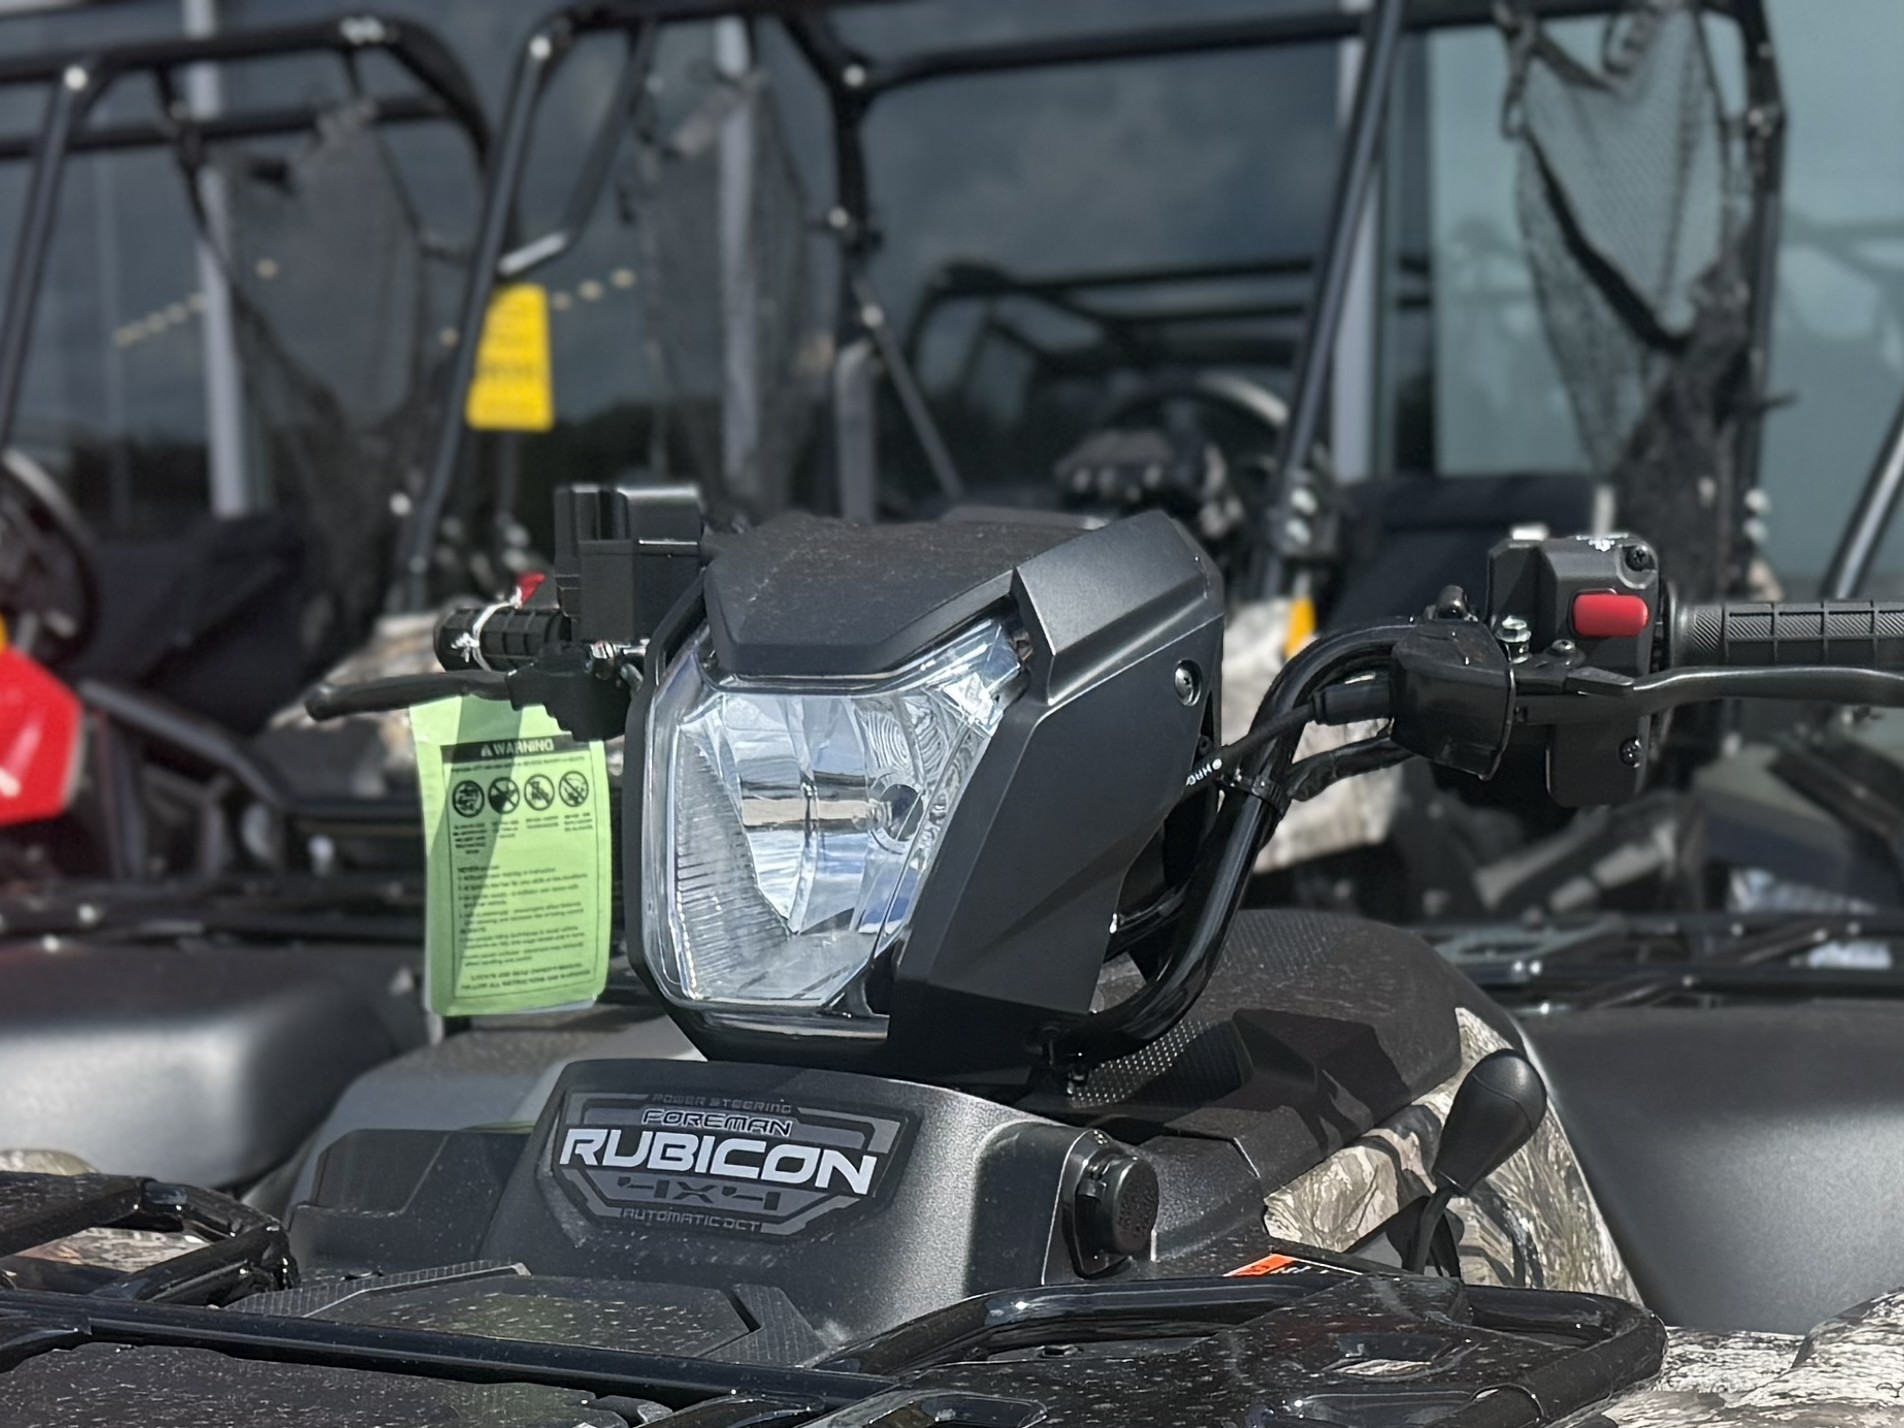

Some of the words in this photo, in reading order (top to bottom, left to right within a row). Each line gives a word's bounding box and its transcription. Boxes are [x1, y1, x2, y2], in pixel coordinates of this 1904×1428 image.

[493, 738, 554, 756] WARNING
[641, 1108, 794, 1138] FOREMAN
[558, 1127, 878, 1196] RUBICON
[622, 1207, 721, 1228] AUTOMATIC
[722, 1220, 762, 1232] DCT
